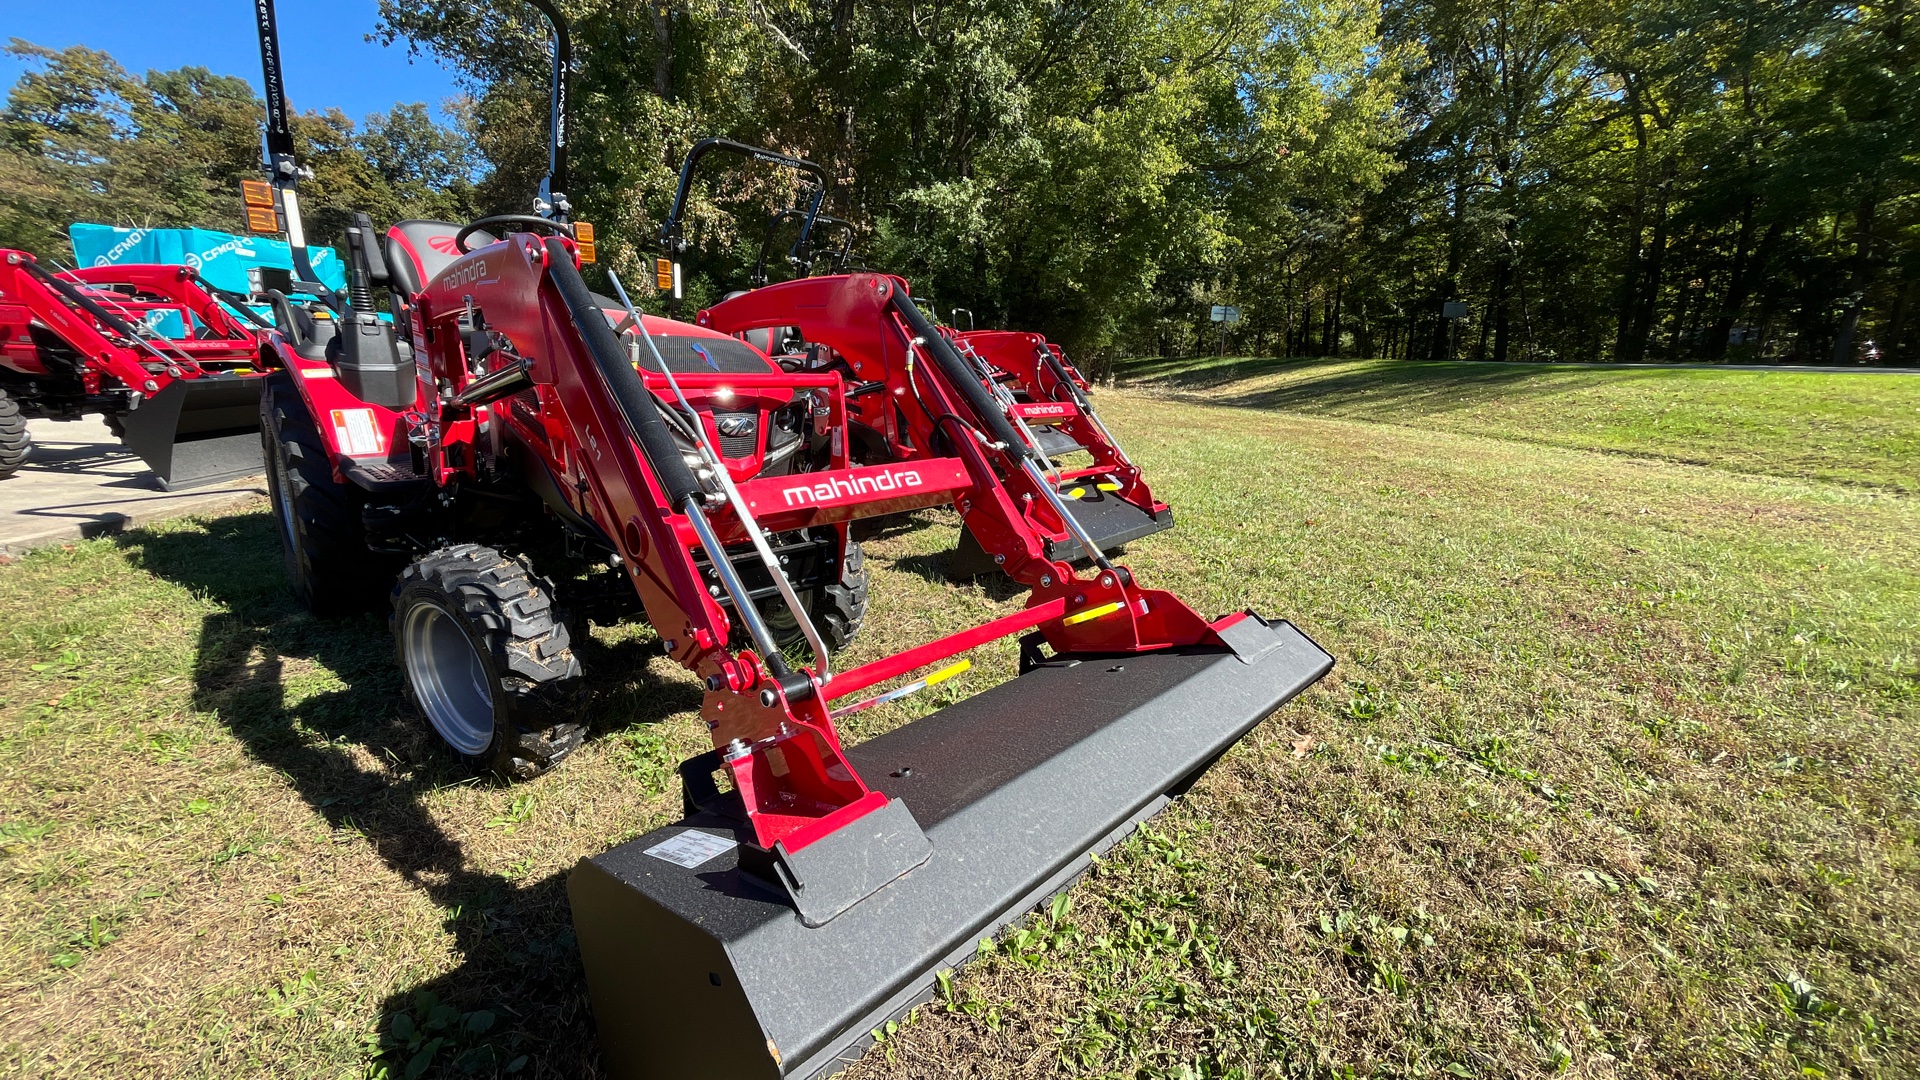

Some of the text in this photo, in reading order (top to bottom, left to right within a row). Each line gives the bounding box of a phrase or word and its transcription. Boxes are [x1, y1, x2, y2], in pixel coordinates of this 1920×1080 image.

[107, 228, 153, 261] CFMOT
[443, 259, 487, 292] mahindra
[1023, 404, 1064, 415] mahindra
[783, 469, 923, 506] mahindra
